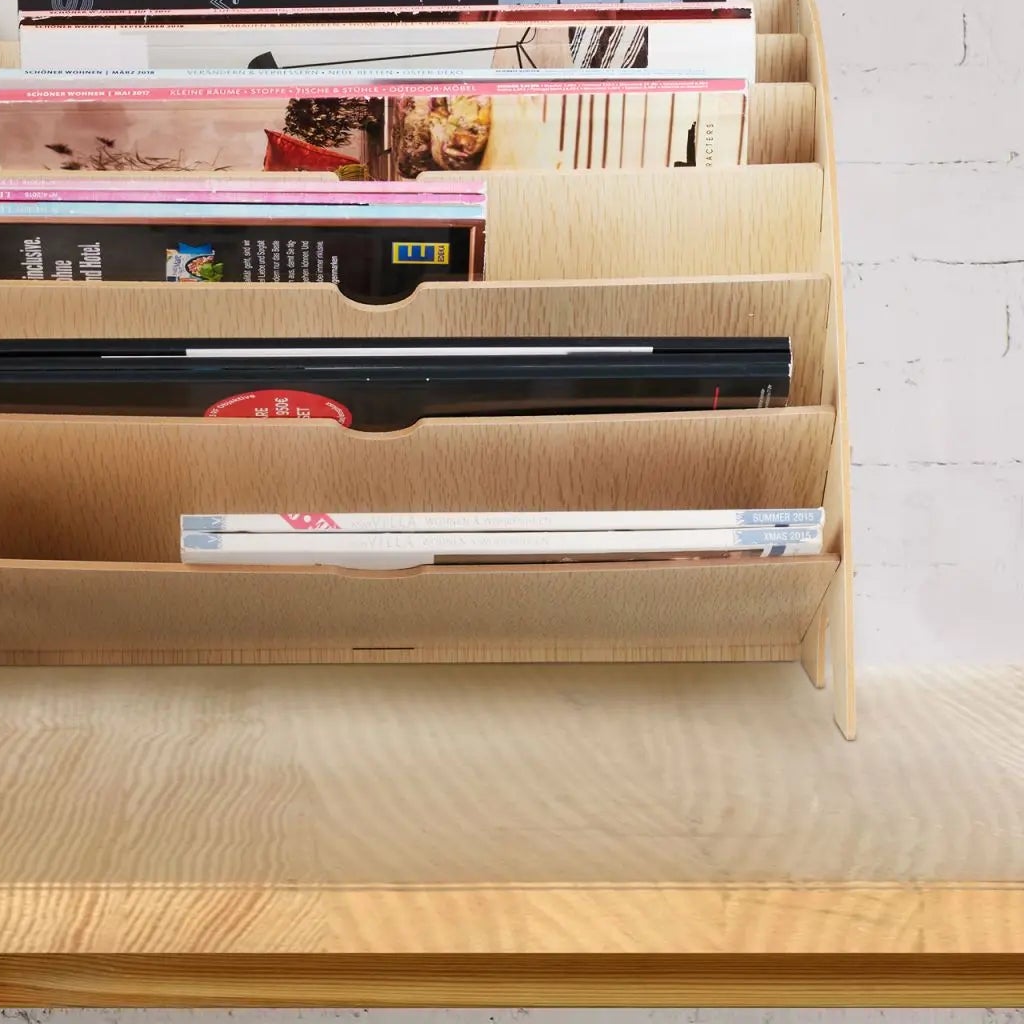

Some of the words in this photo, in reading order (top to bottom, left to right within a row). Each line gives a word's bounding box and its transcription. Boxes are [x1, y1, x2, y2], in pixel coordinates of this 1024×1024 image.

[207, 87, 241, 95] RÄUME
[342, 85, 378, 93] STÜHLE
[77, 241, 102, 268] Hotel.
[752, 512, 790, 522] SUMMER
[793, 512, 814, 522] 2015
[763, 531, 788, 541] XMAS
[790, 531, 812, 541] 2015
